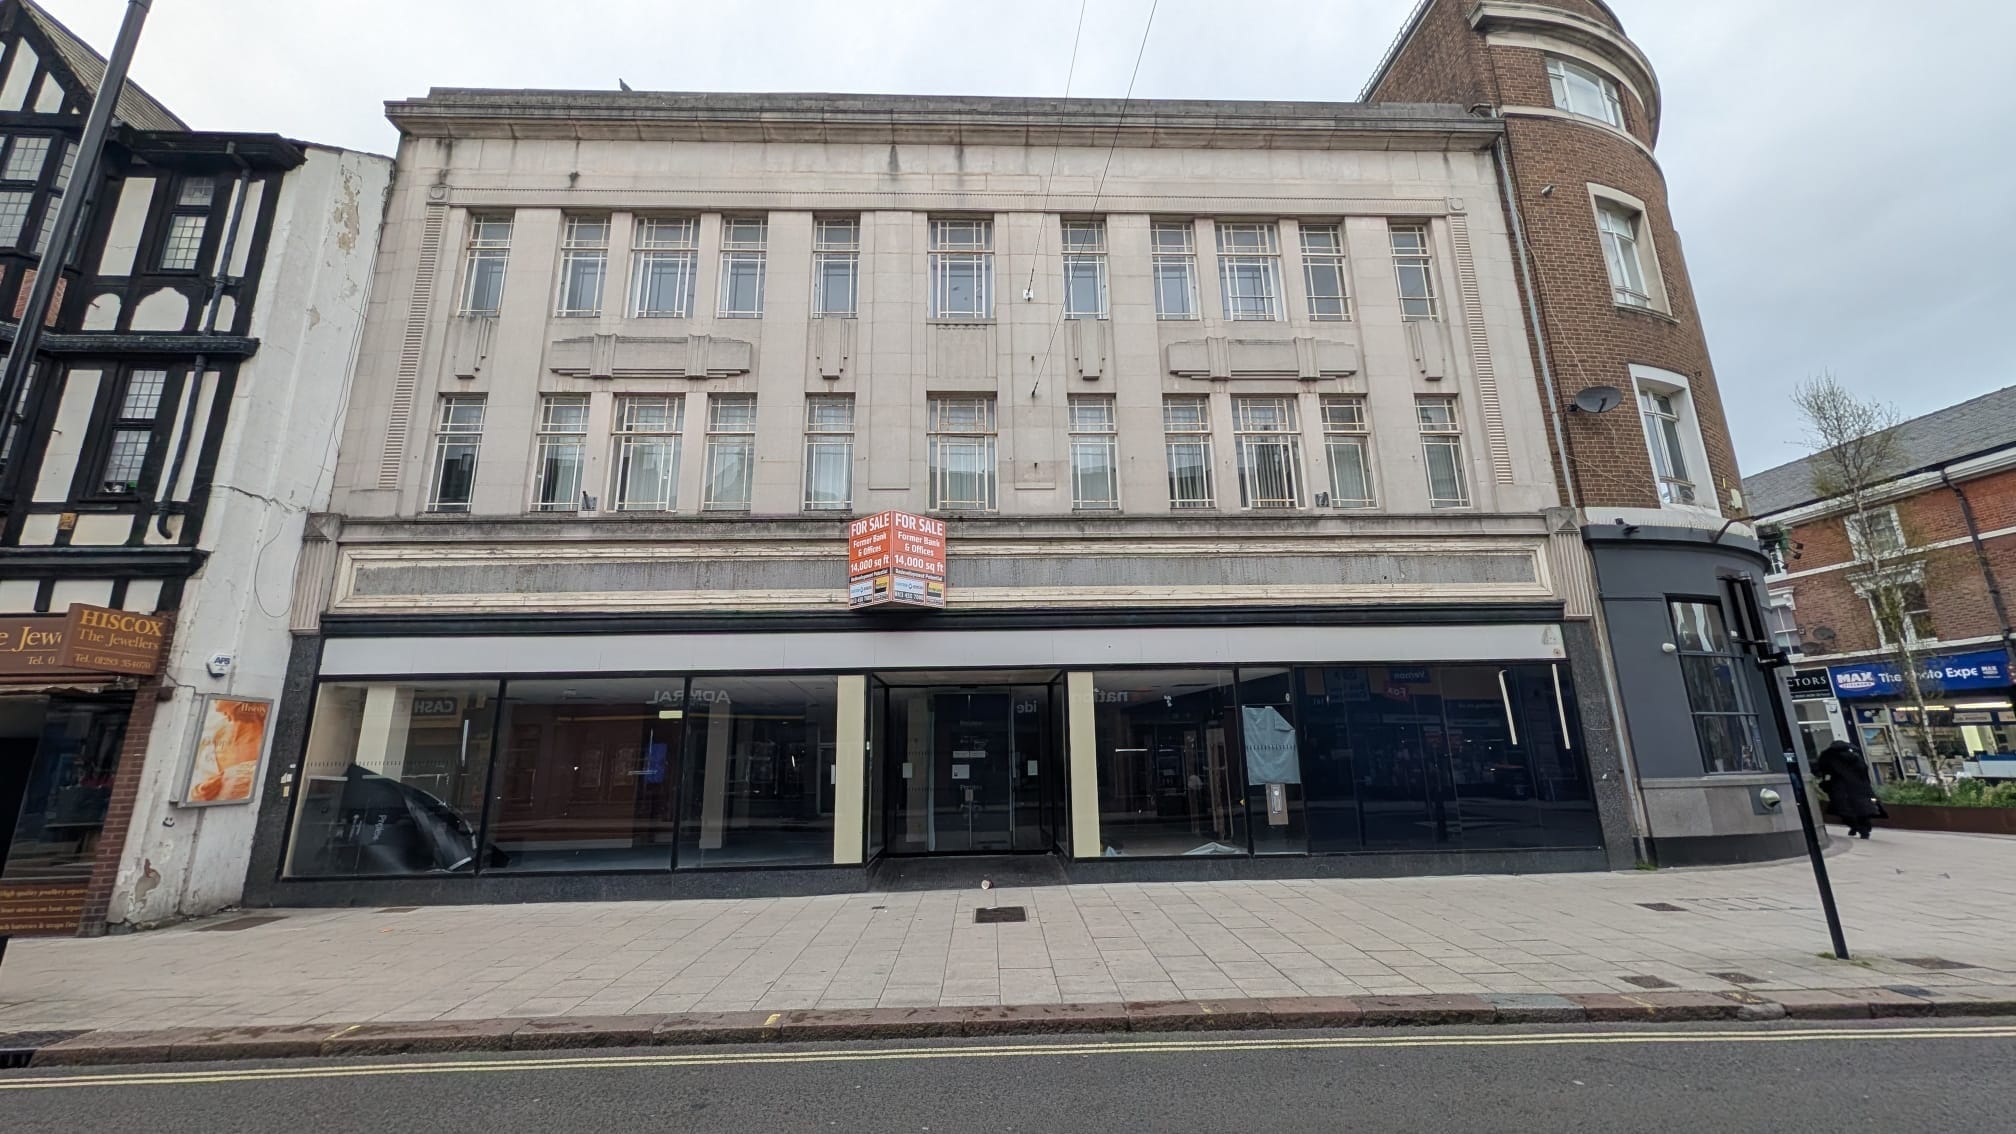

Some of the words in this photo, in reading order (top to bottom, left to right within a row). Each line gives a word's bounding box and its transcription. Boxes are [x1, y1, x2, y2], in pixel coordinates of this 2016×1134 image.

[851, 521, 867, 536] FOR
[869, 513, 890, 531] SALE
[895, 513, 916, 530] FOR
[919, 518, 943, 536] SALE
[853, 537, 872, 548] Former
[873, 532, 887, 542] Bank
[898, 531, 922, 543] Former
[924, 536, 940, 547] Bank
[858, 549, 862, 557] &
[863, 545, 882, 555] Offices
[905, 543, 910, 551] &
[911, 544, 934, 556] Offices
[851, 558, 873, 573] 14,000
[874, 558, 882, 568] sq
[883, 554, 890, 564] ft
[895, 554, 924, 569] 14,000
[925, 562, 935, 573] sq
[937, 561, 944, 572] ft
[79, 609, 164, 637] HISCOX
[79, 627, 104, 642] The
[105, 632, 159, 650] Jewellers
[214, 656, 231, 665] APS
[1836, 671, 1874, 684] MAX
[1878, 672, 1903, 682] The
